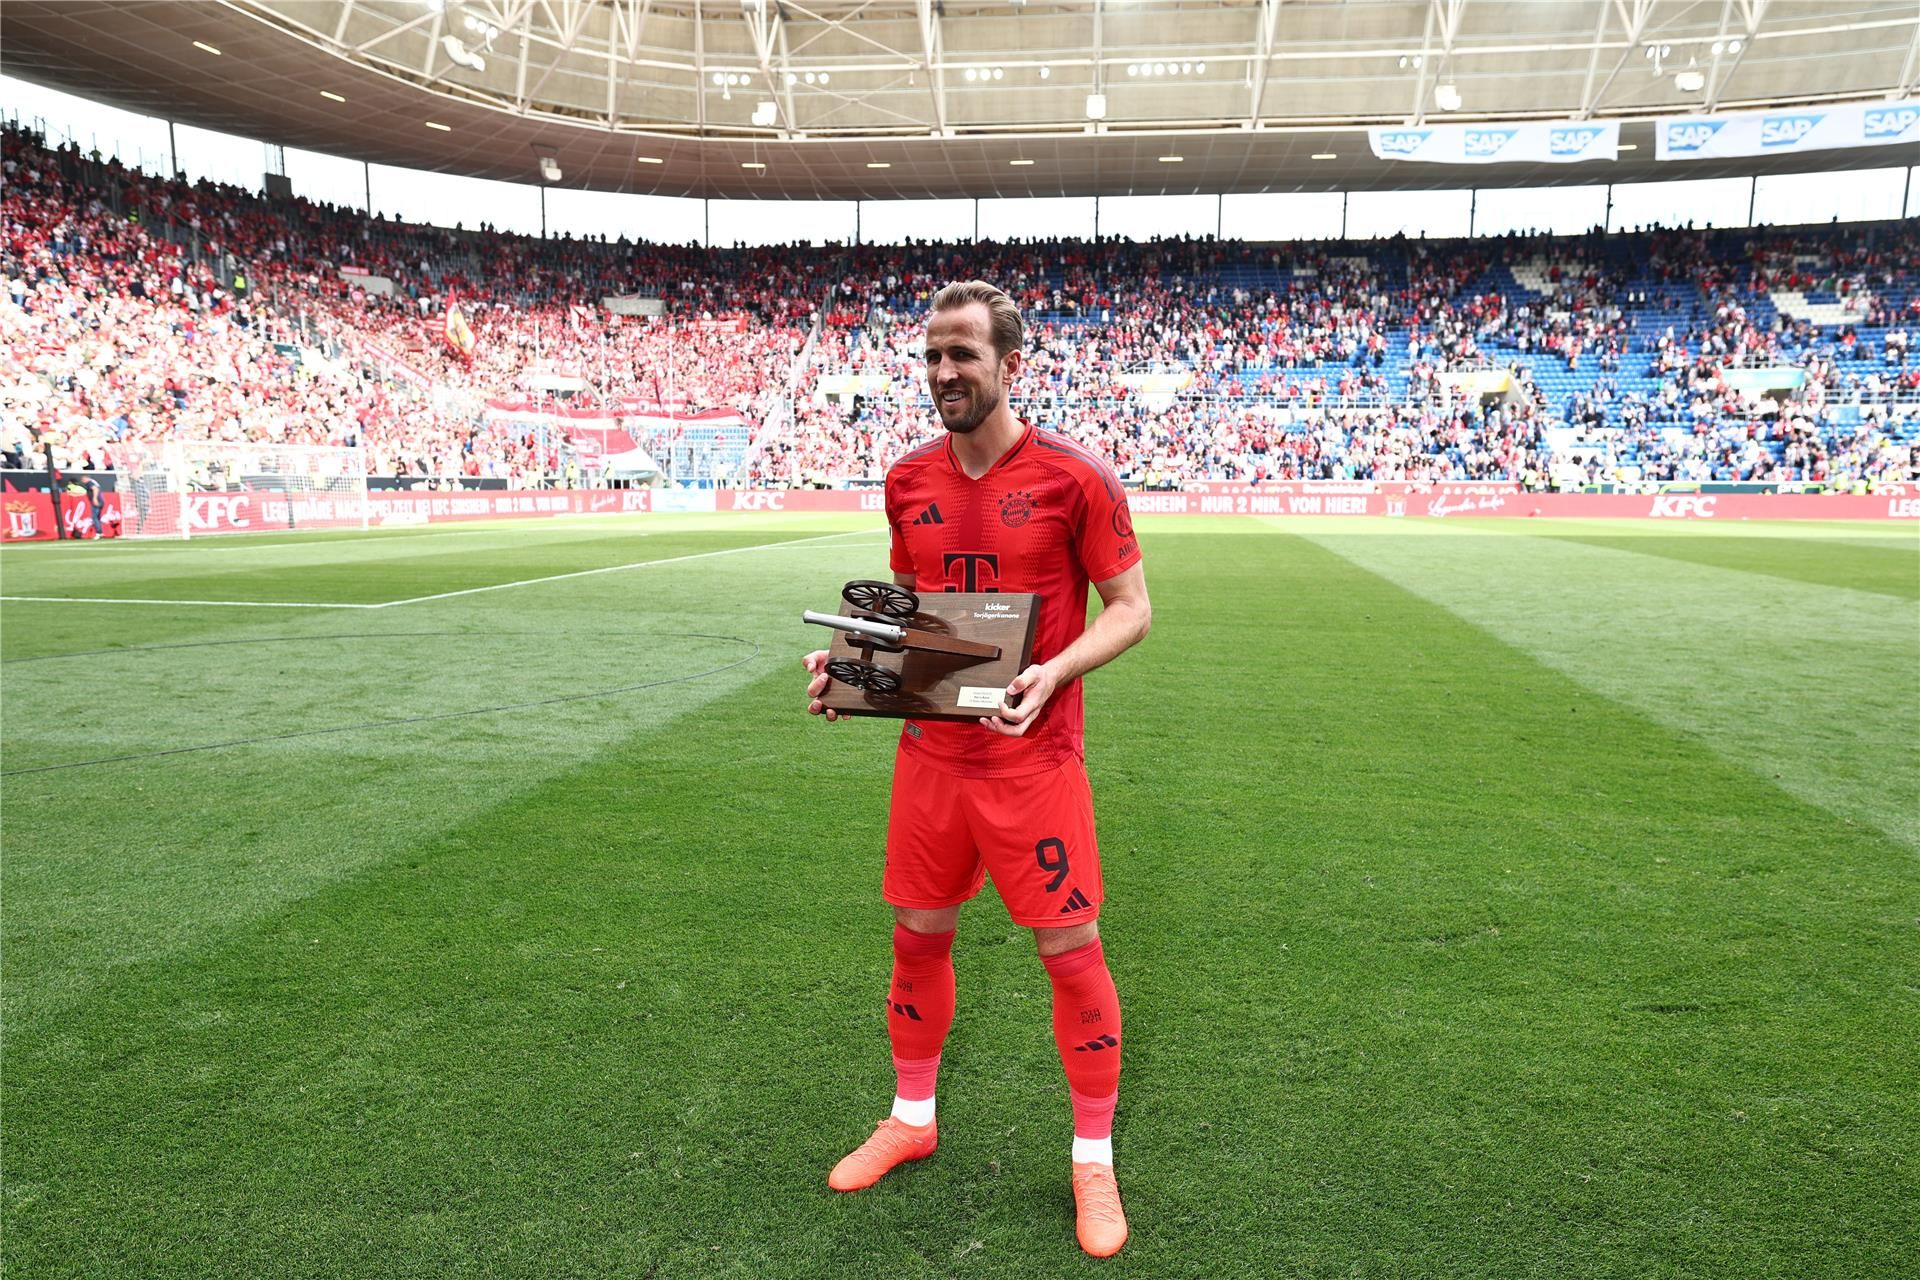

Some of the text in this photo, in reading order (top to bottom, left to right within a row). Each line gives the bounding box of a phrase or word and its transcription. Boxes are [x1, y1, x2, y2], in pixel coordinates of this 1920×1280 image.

[1762, 119, 1811, 141] SAP
[1865, 111, 1917, 134] SAP
[1382, 135, 1422, 149] SAP
[1466, 133, 1508, 150] SAP
[1551, 131, 1594, 149] SAP
[1669, 126, 1713, 148] SAP
[622, 491, 647, 510] KFC
[732, 492, 784, 510] KFC
[1201, 497, 1233, 512] NUR
[1237, 497, 1247, 512] 2
[1251, 497, 1284, 512] MIN.
[1289, 497, 1321, 512] VON
[1325, 497, 1367, 512] HIER!
[1649, 496, 1716, 516] KFC
[179, 496, 250, 528] KFC
[944, 552, 999, 593] T
[985, 602, 1010, 611] kicker
[1035, 836, 1070, 893] 9
